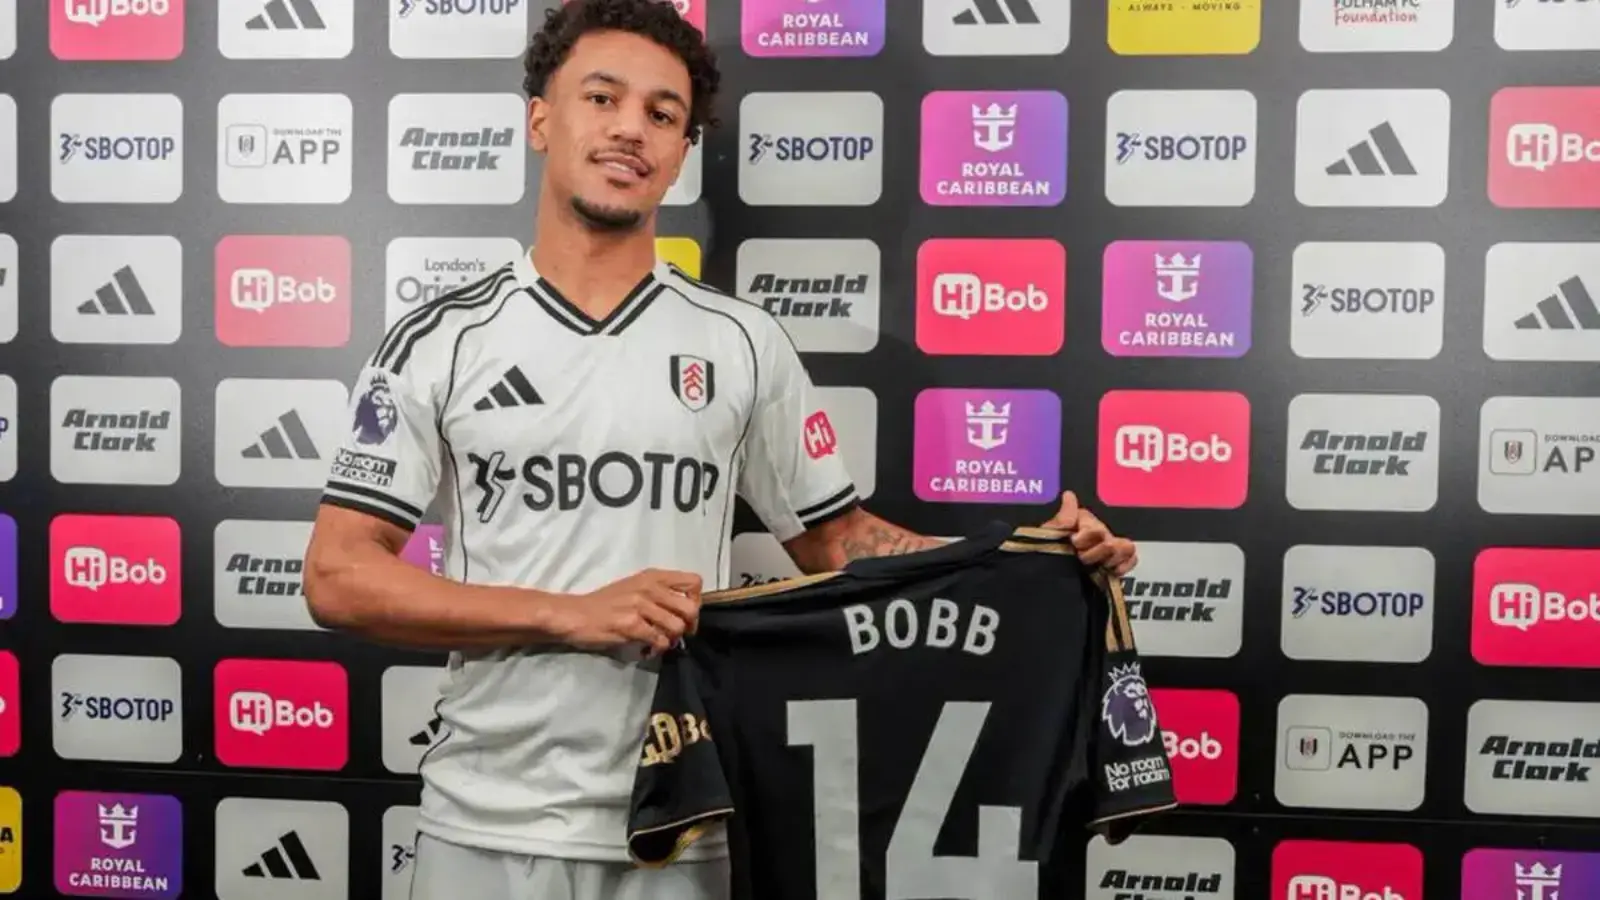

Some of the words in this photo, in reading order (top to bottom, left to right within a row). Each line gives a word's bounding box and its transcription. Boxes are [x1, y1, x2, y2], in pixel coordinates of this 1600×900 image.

[1128, 3, 1173, 11] ALWAYS
[1193, 3, 1241, 11] MOVING
[1335, 8, 1418, 26] Foundation
[782, 14, 844, 28] ROYAL
[758, 32, 869, 46] CARIBBEAN
[273, 128, 324, 136] DOWNLOAD
[326, 128, 342, 136] THE
[400, 127, 514, 147] Arnold
[85, 137, 175, 161] SBOTOP
[272, 140, 341, 164] APP
[775, 137, 873, 161] SBOTOP
[1144, 135, 1247, 161] SBOTOP
[411, 150, 501, 171] Clark
[962, 163, 1024, 177] ROYAL
[936, 181, 1050, 196] CARIBBEAN
[424, 257, 486, 272] London's
[748, 273, 869, 295] Arnold
[761, 296, 852, 318] Clark
[1330, 288, 1435, 314] SBOTOP
[1145, 313, 1208, 328] ROYAL
[1119, 331, 1234, 347] CARIBBEAN
[62, 409, 171, 429] Arnold
[74, 431, 156, 452] Clark
[1300, 429, 1428, 452] Arnold
[955, 460, 1017, 475] ROYAL
[1313, 454, 1411, 476] Clark
[521, 450, 719, 513] SBOTOP
[930, 478, 1043, 494] CARIBBEAN
[238, 576, 305, 597] Clar
[1128, 600, 1217, 622] Clark
[1320, 591, 1424, 617] SBOTOP
[843, 598, 1000, 655] BOBB
[86, 698, 173, 721] SBOTOP
[1339, 731, 1395, 741] DOWNLOAD
[1398, 732, 1416, 742] THE
[1336, 743, 1413, 770] APP
[1104, 762, 1129, 779] No
[1492, 759, 1591, 782] Clark
[786, 698, 1039, 900] 14
[90, 858, 147, 873] ROYAL
[69, 874, 169, 891] CARIBBEAN
[1099, 870, 1221, 893] Arnold
